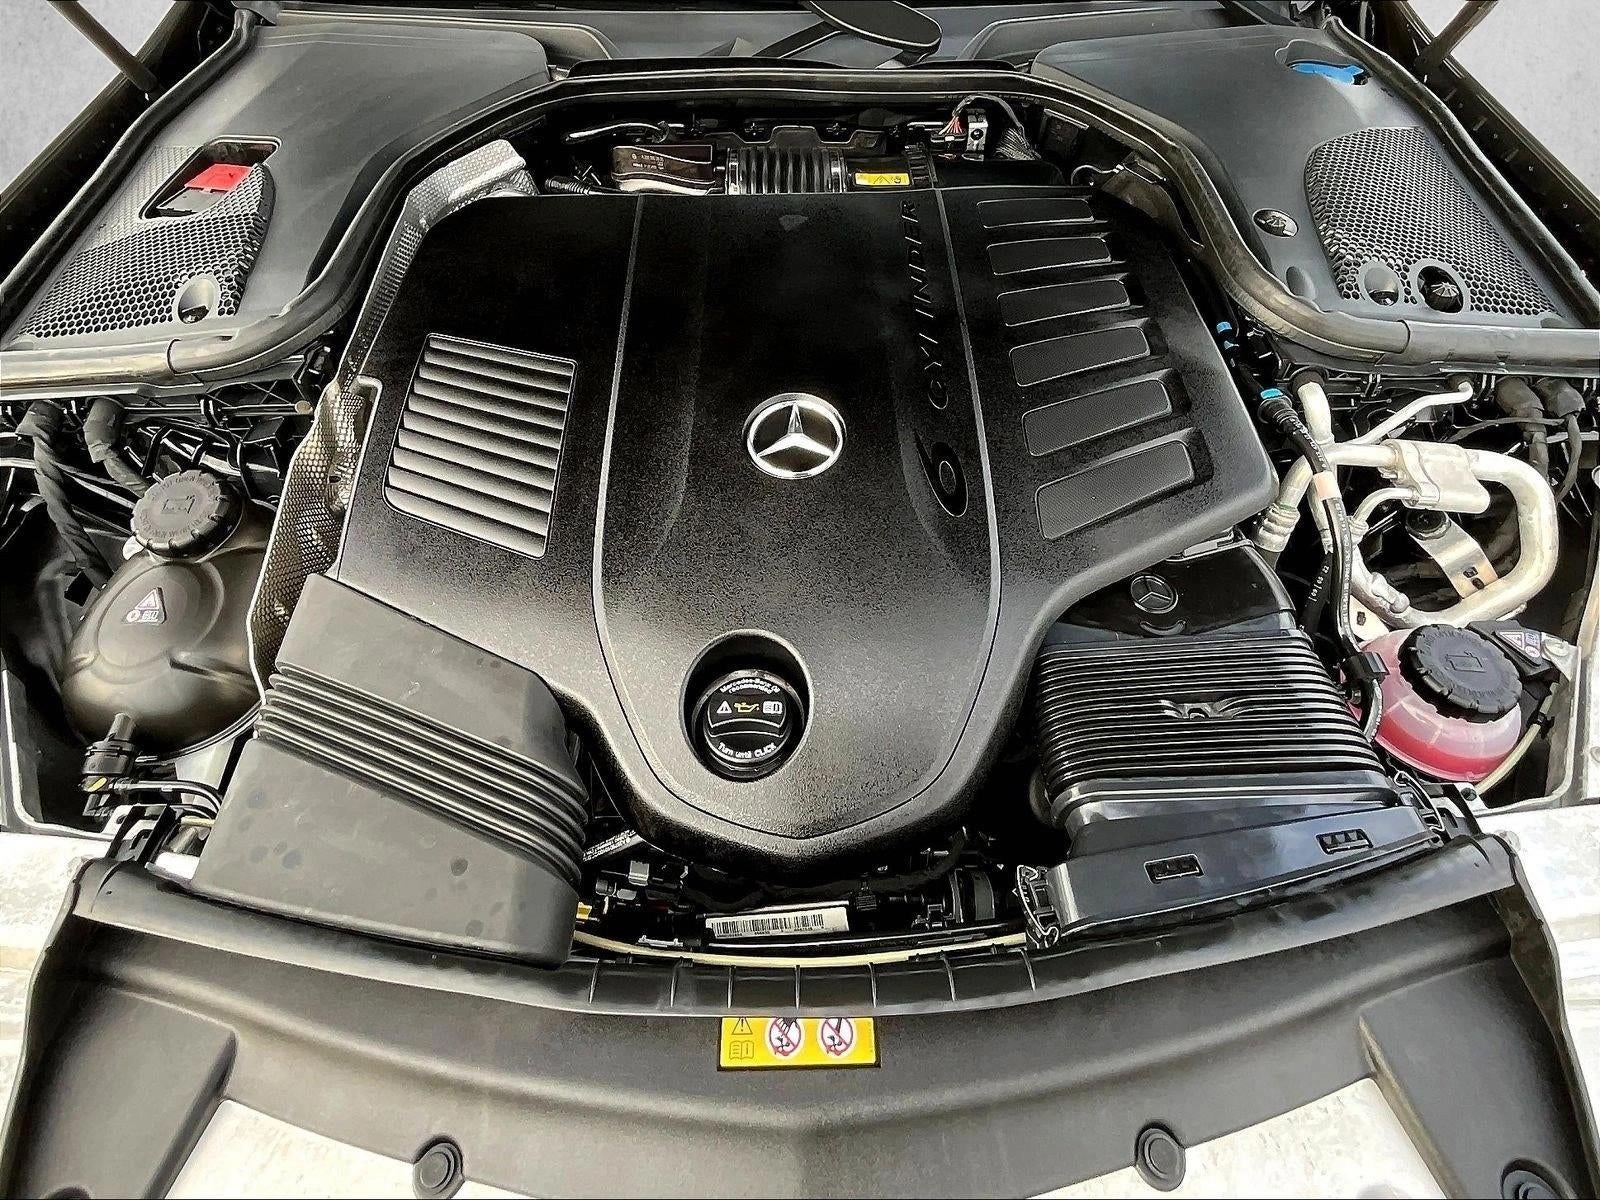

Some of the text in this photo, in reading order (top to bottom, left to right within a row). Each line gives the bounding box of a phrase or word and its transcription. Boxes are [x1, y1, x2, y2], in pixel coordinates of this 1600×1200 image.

[717, 741, 777, 759] Turn until CLICK
